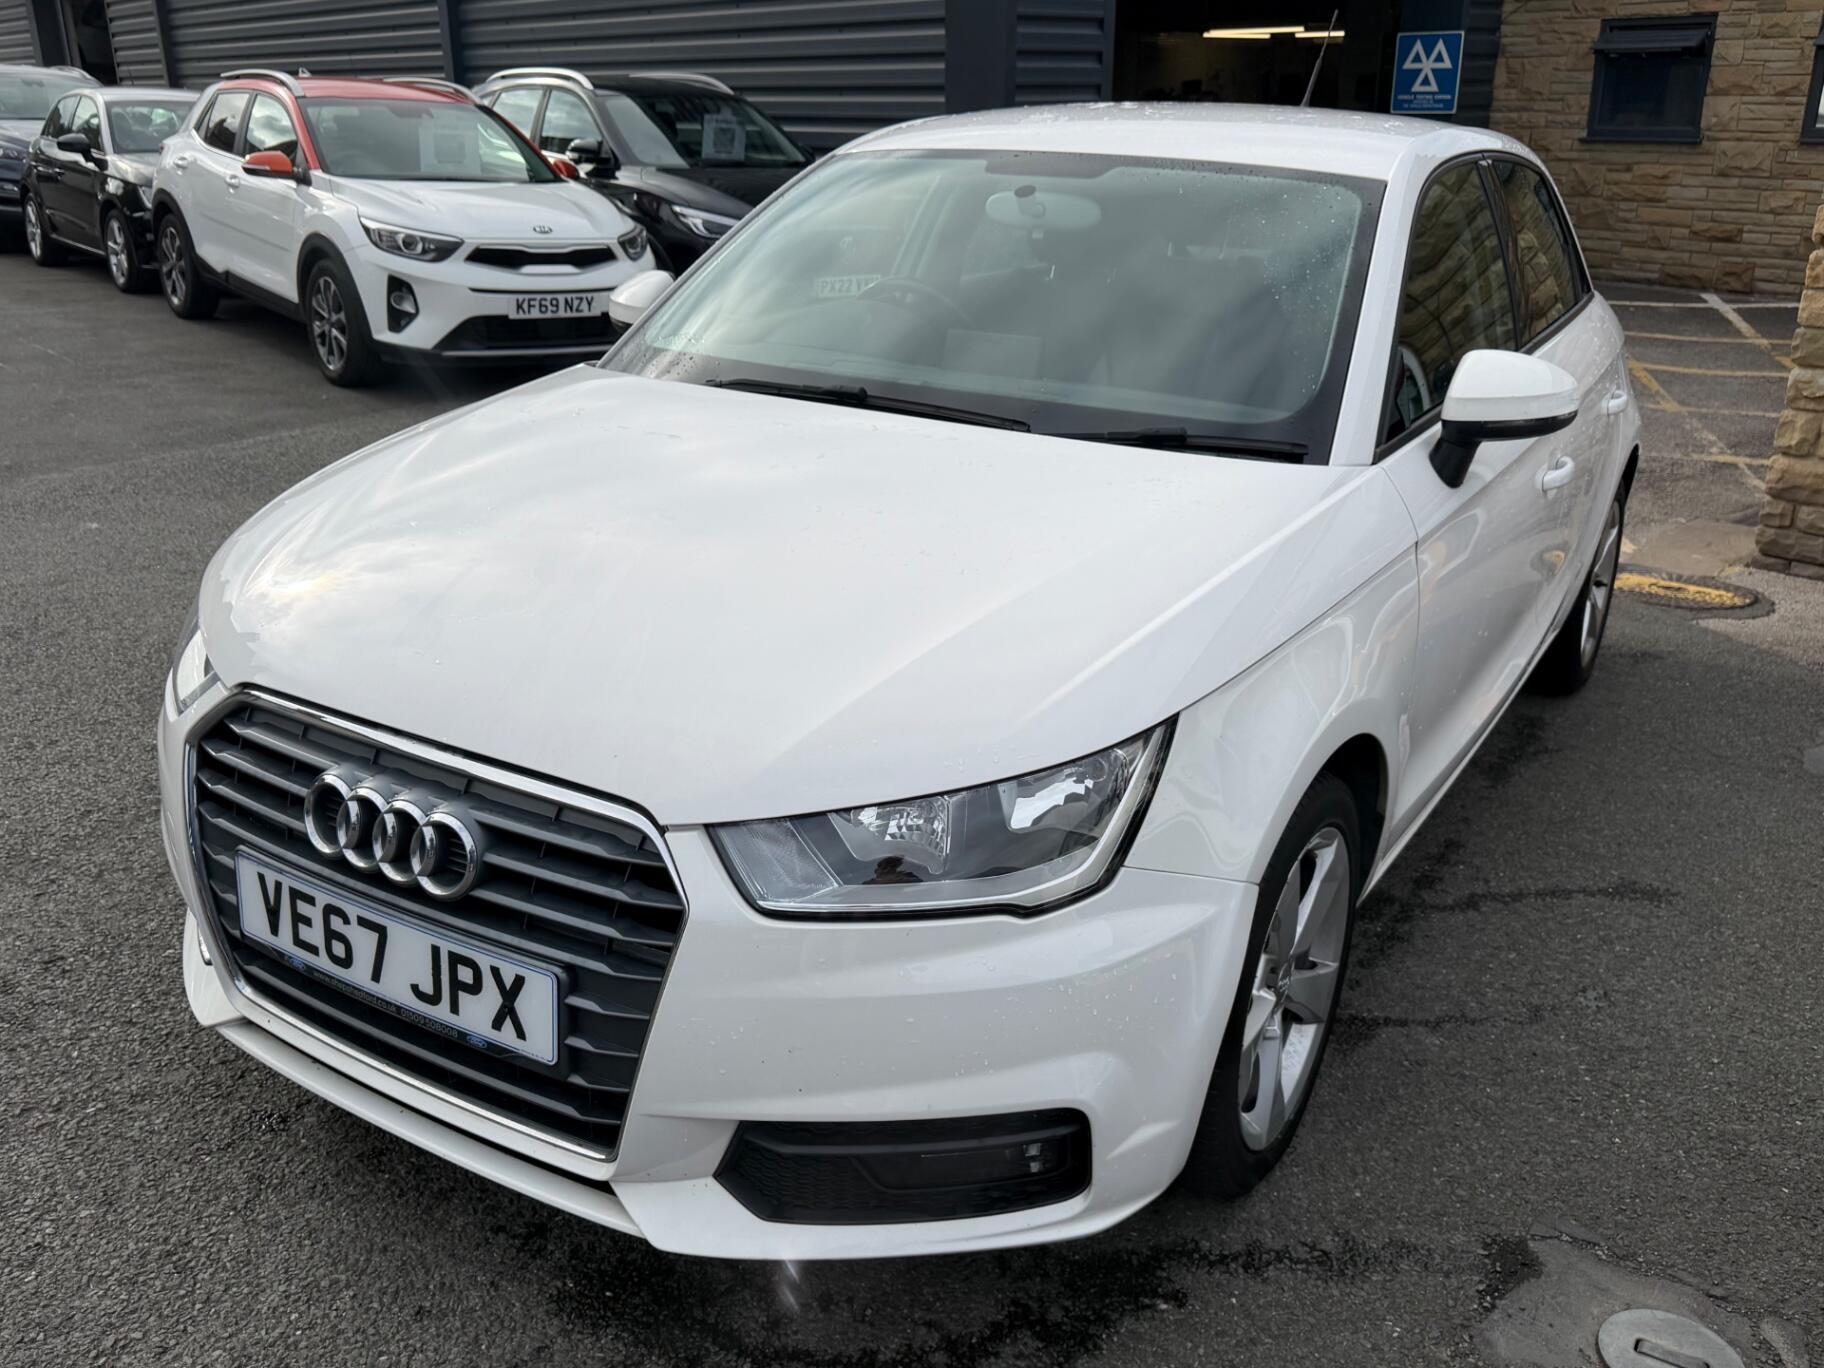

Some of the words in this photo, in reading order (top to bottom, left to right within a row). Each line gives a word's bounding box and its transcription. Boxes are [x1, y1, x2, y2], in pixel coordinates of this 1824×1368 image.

[515, 297, 560, 315] KF69
[563, 295, 595, 313] NZY
[256, 871, 388, 984] VE67
[409, 943, 527, 1042] JPX
